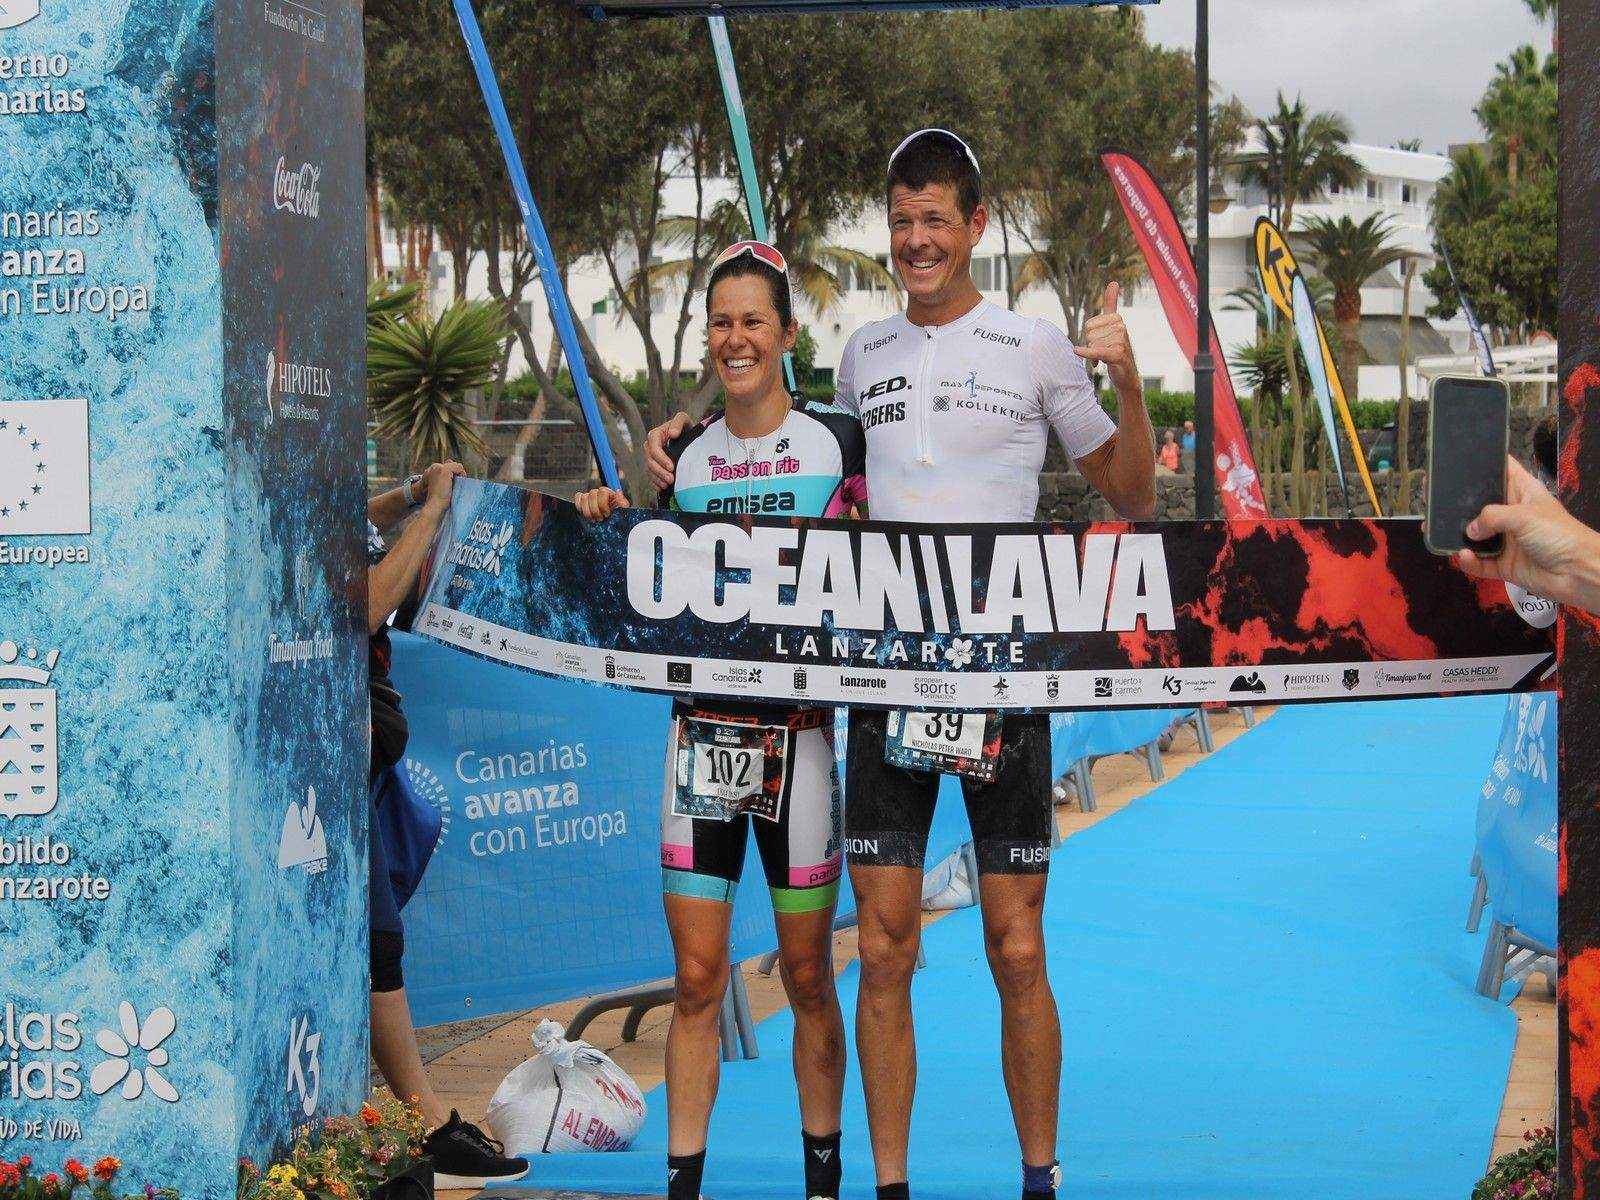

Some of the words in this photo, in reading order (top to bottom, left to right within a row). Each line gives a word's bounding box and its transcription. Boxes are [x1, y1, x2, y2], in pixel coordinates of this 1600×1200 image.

[2, 202, 101, 237] narias
[2, 248, 85, 276] anza
[32, 279, 149, 320] Europa
[863, 332, 898, 354] FUSION
[972, 327, 1022, 348] FUSION
[279, 362, 331, 398] HIPOTELS
[706, 491, 796, 514] emsea
[0, 541, 89, 569] Europea
[616, 665, 641, 674] Gobierno
[623, 673, 646, 681] Canarias
[711, 673, 748, 683] Canarias
[728, 665, 748, 675] Islas
[1290, 674, 1330, 684] HIPOTELS
[1384, 673, 1417, 684] Timanfaya
[1417, 672, 1432, 681] Food
[1442, 667, 1470, 677] CASAS
[1470, 665, 1500, 676] HEDDY
[840, 675, 887, 689] Lanzarote
[913, 681, 957, 696] sports
[1162, 675, 1182, 696] K3
[924, 712, 964, 742] 39
[911, 739, 938, 751] NICHOLAS
[938, 743, 955, 753] PETER
[955, 745, 972, 757] WARD
[455, 739, 588, 785] Canarias
[705, 747, 752, 788] 102
[464, 781, 580, 820] avanza
[469, 825, 526, 857] con
[534, 809, 628, 848] Europa
[0, 835, 70, 865] bildo
[0, 871, 110, 900] nzarote
[286, 1013, 321, 1117] K3
[25, 1119, 43, 1140] DE
[47, 1119, 83, 1141] VIDA
[289, 1118, 319, 1142] EVETOS
[561, 1108, 581, 1140] AL
